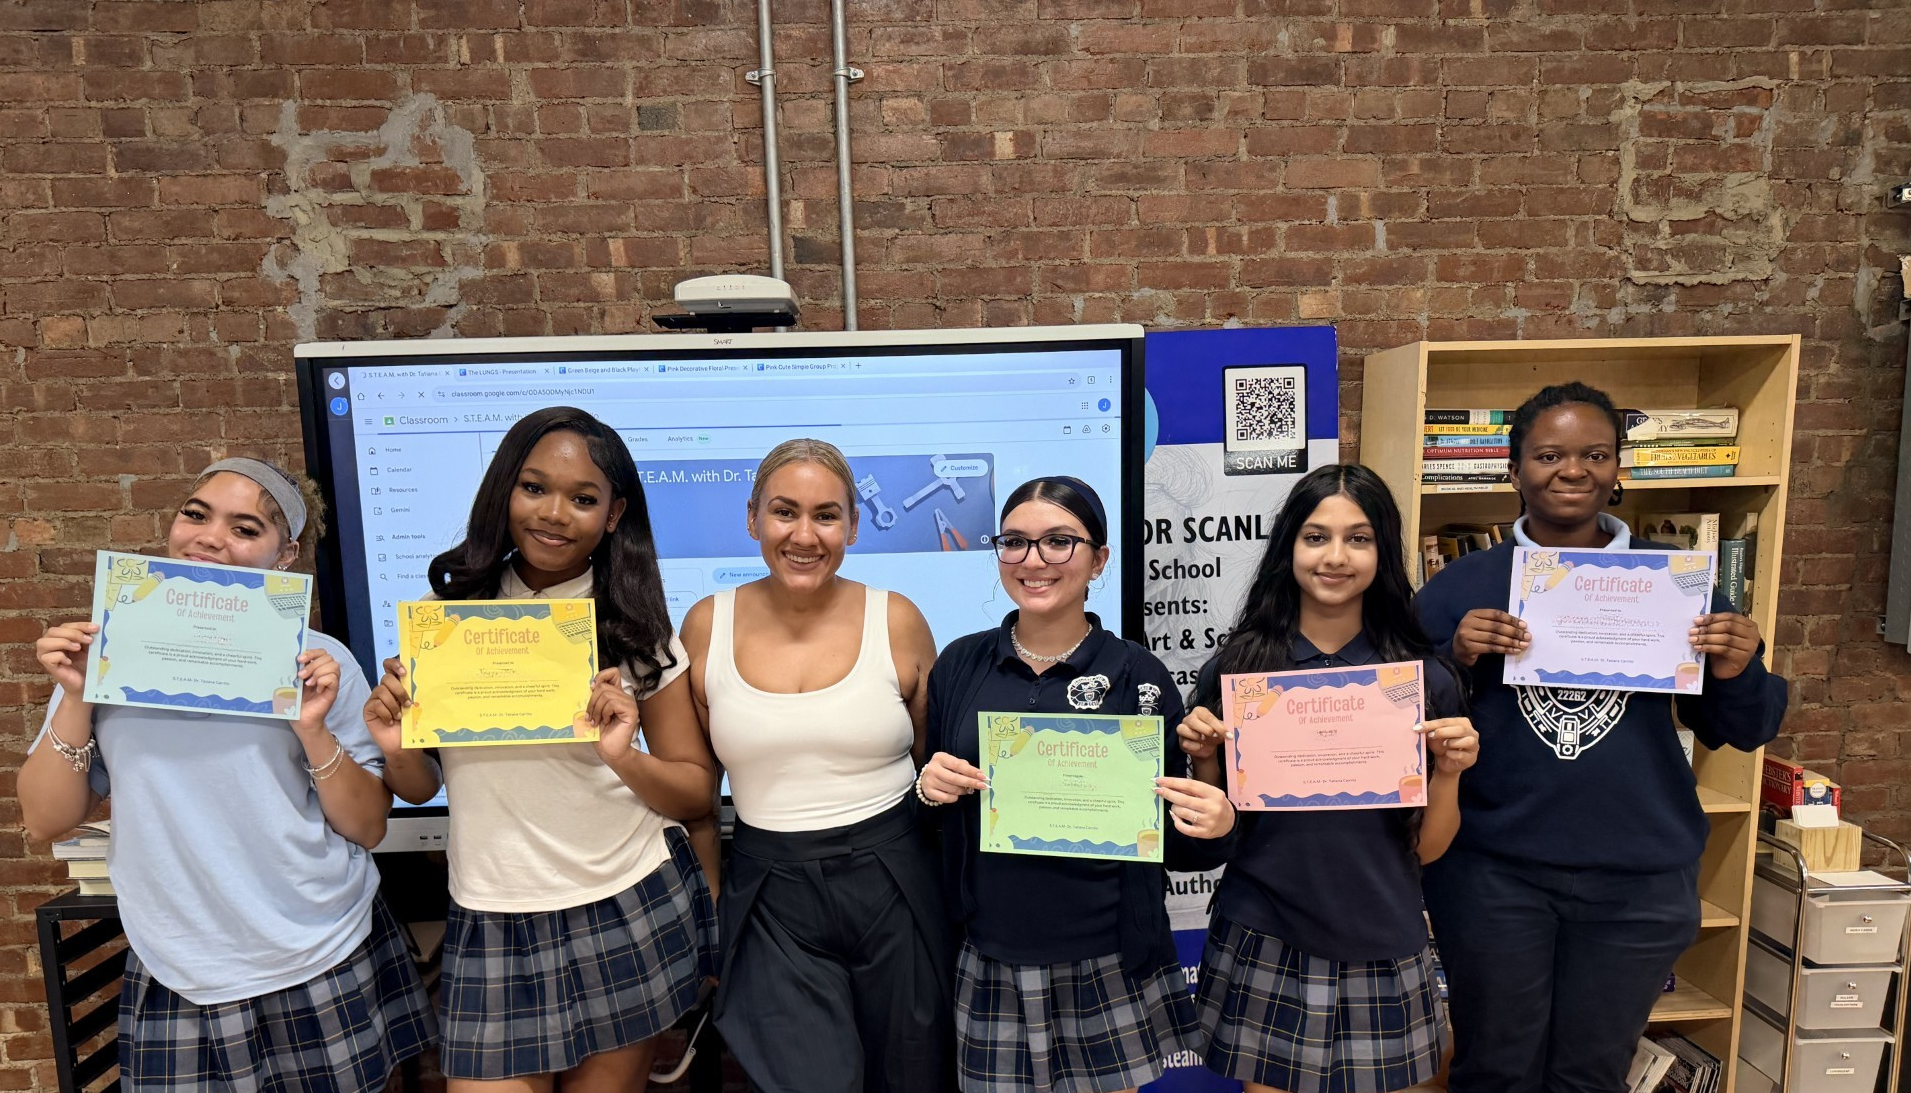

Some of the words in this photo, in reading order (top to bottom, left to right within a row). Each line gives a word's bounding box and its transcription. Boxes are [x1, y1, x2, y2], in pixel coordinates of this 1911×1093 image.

[584, 367, 600, 375] Beige
[336, 402, 342, 411] J
[400, 414, 449, 425] Classroom
[464, 414, 503, 423] S.T.E.A.M.
[950, 463, 979, 472] Customize
[1236, 456, 1273, 470] SCAN
[1277, 455, 1297, 468] ME
[691, 469, 720, 483] with
[723, 469, 741, 483] Dr.
[1149, 556, 1221, 581] School
[1730, 547, 1738, 580] Illustrated
[1575, 575, 1653, 593] Certificate
[1594, 594, 1640, 603] Achievement
[1729, 581, 1738, 602] Guide
[165, 588, 249, 613] Certificate
[188, 609, 235, 623] Achievement
[463, 628, 541, 645] Certificate
[1179, 628, 1196, 650] &
[486, 646, 530, 655] Achievement
[1557, 689, 1587, 702] 22262
[1286, 695, 1366, 715] Certificate
[1309, 714, 1354, 724] Achievement
[1036, 740, 1109, 758] Certificate
[1057, 759, 1098, 769] Achievement
